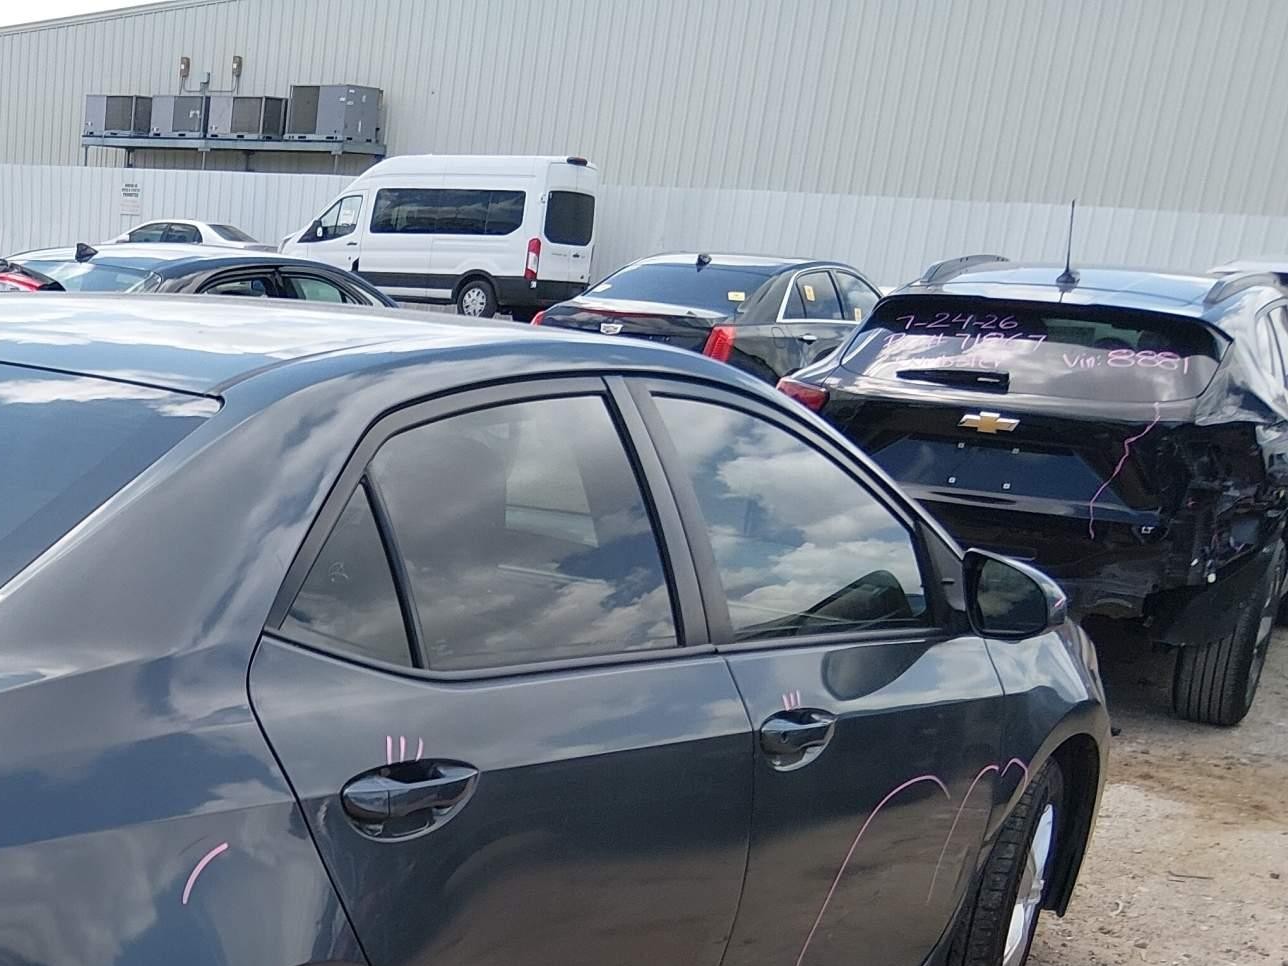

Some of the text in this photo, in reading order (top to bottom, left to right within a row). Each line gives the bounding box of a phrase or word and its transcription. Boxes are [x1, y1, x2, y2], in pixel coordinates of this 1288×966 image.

[896, 312, 1018, 330] 7-24-26
[1062, 348, 1190, 375] Vin: 8881
